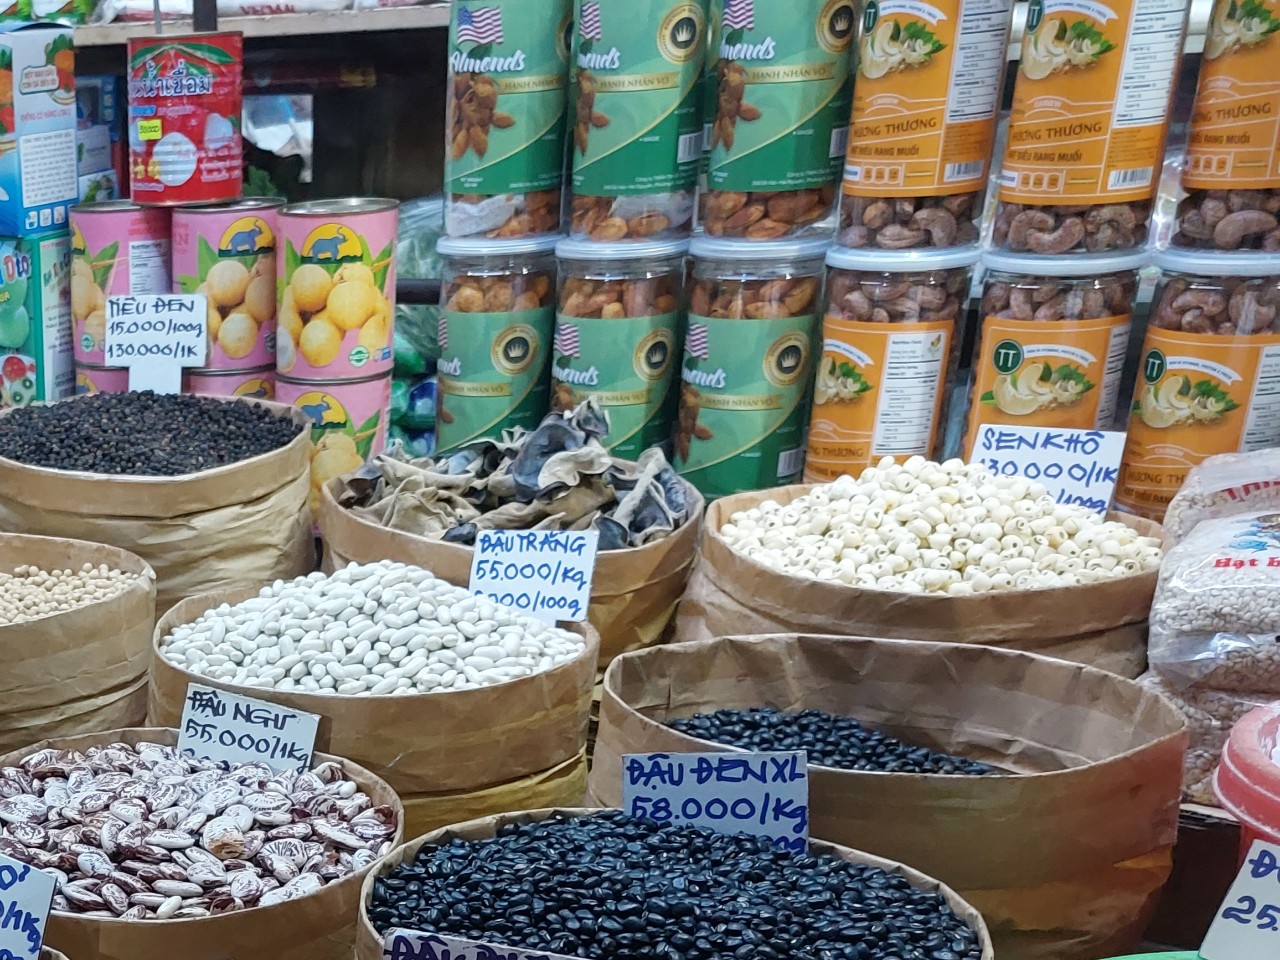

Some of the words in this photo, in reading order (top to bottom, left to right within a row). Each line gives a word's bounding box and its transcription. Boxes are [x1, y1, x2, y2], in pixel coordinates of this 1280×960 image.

[885, 117, 937, 134] THƯƠNG
[1047, 121, 1102, 139] THƯƠNG
[108, 297, 147, 318] TIÊU
[152, 297, 195, 314] ĐEN
[982, 427, 1040, 452] SEN
[1041, 431, 1105, 455] KHÔ
[479, 529, 515, 556] ĐẬU
[516, 530, 587, 556] TRẮNG
[626, 753, 684, 790] ĐẬU
[690, 756, 767, 785] ĐEN
[769, 754, 806, 784] XL
